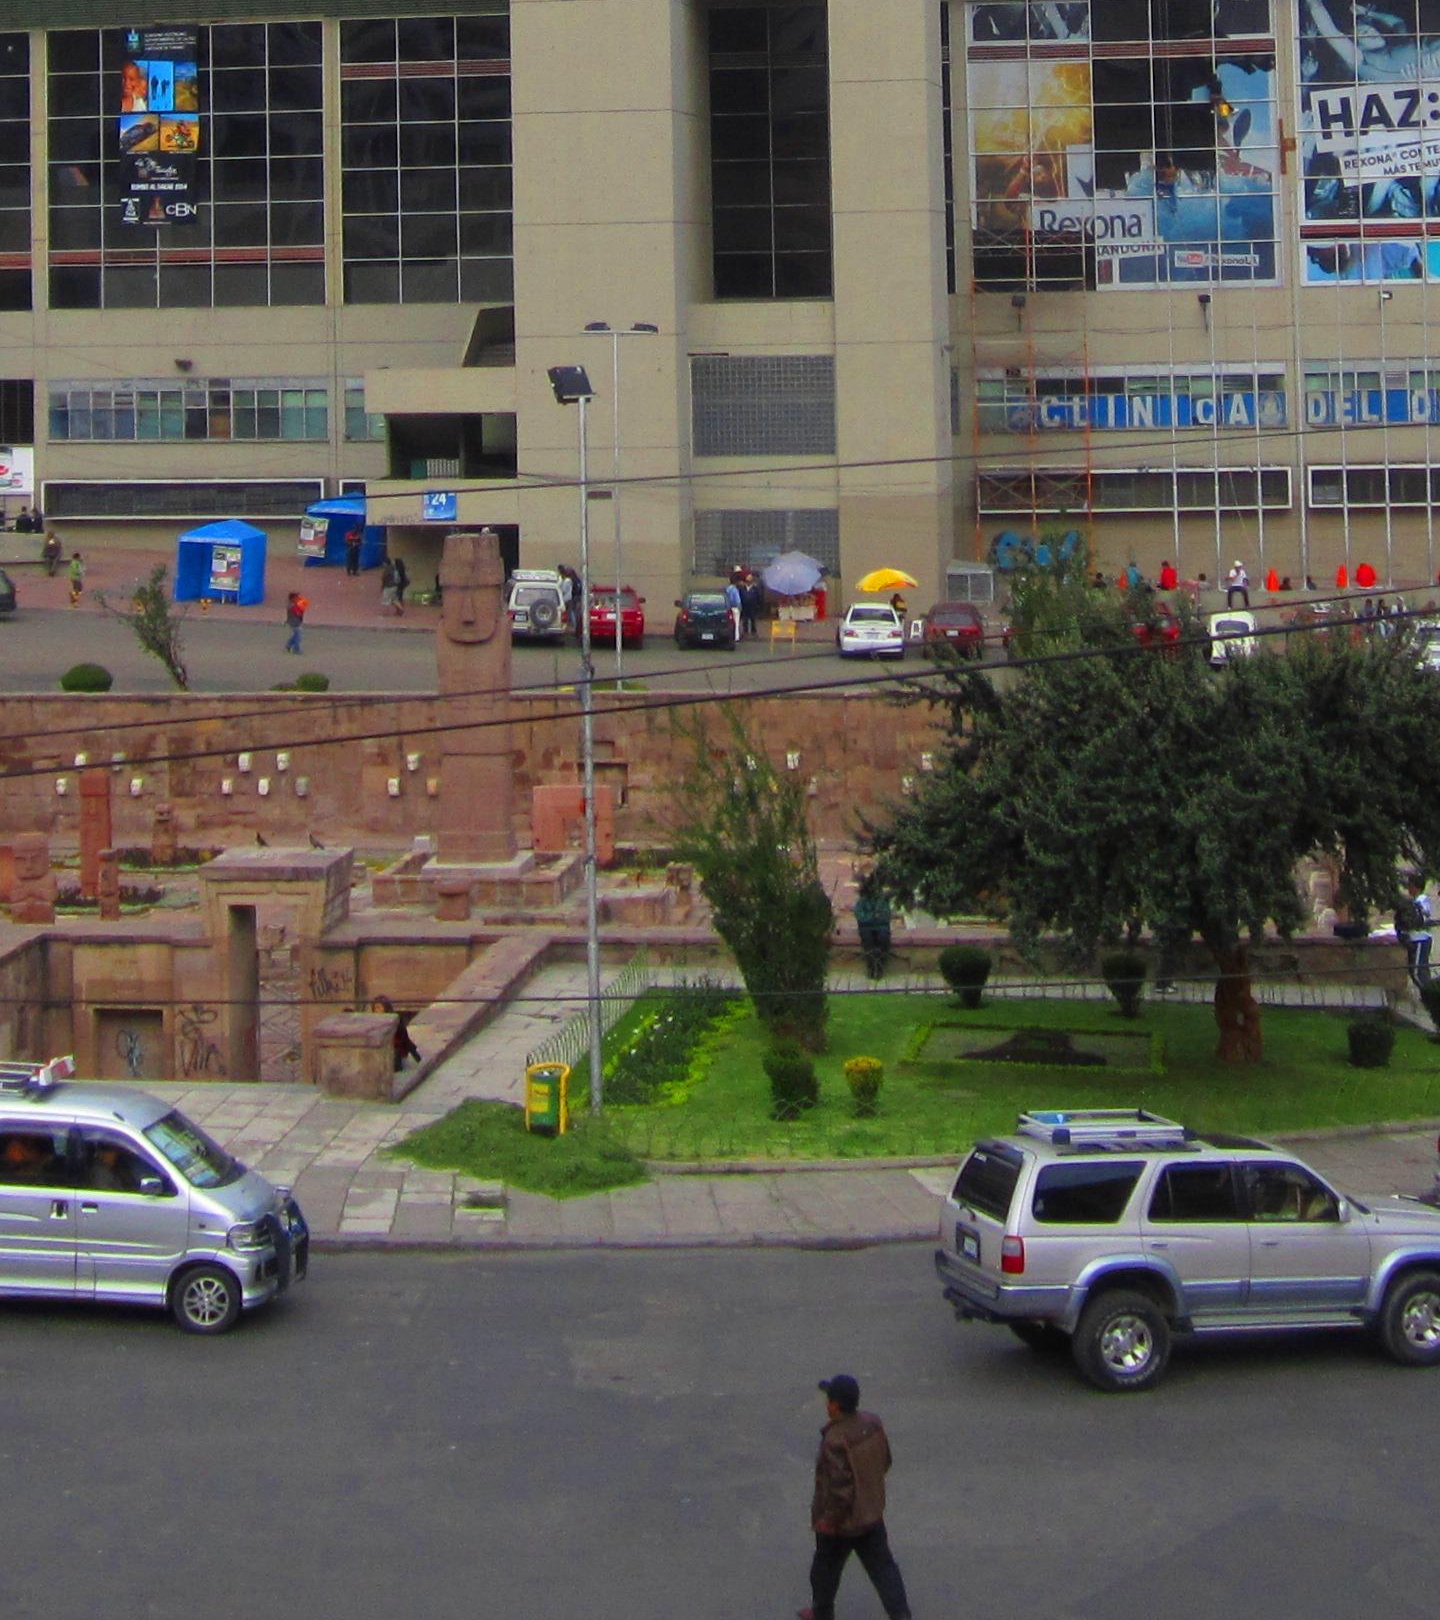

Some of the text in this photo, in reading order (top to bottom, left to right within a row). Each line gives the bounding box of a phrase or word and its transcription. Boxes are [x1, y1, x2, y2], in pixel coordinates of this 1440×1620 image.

[165, 202, 197, 217] CBN
[1307, 389, 1378, 423] DEL
[431, 492, 447, 505] 24
